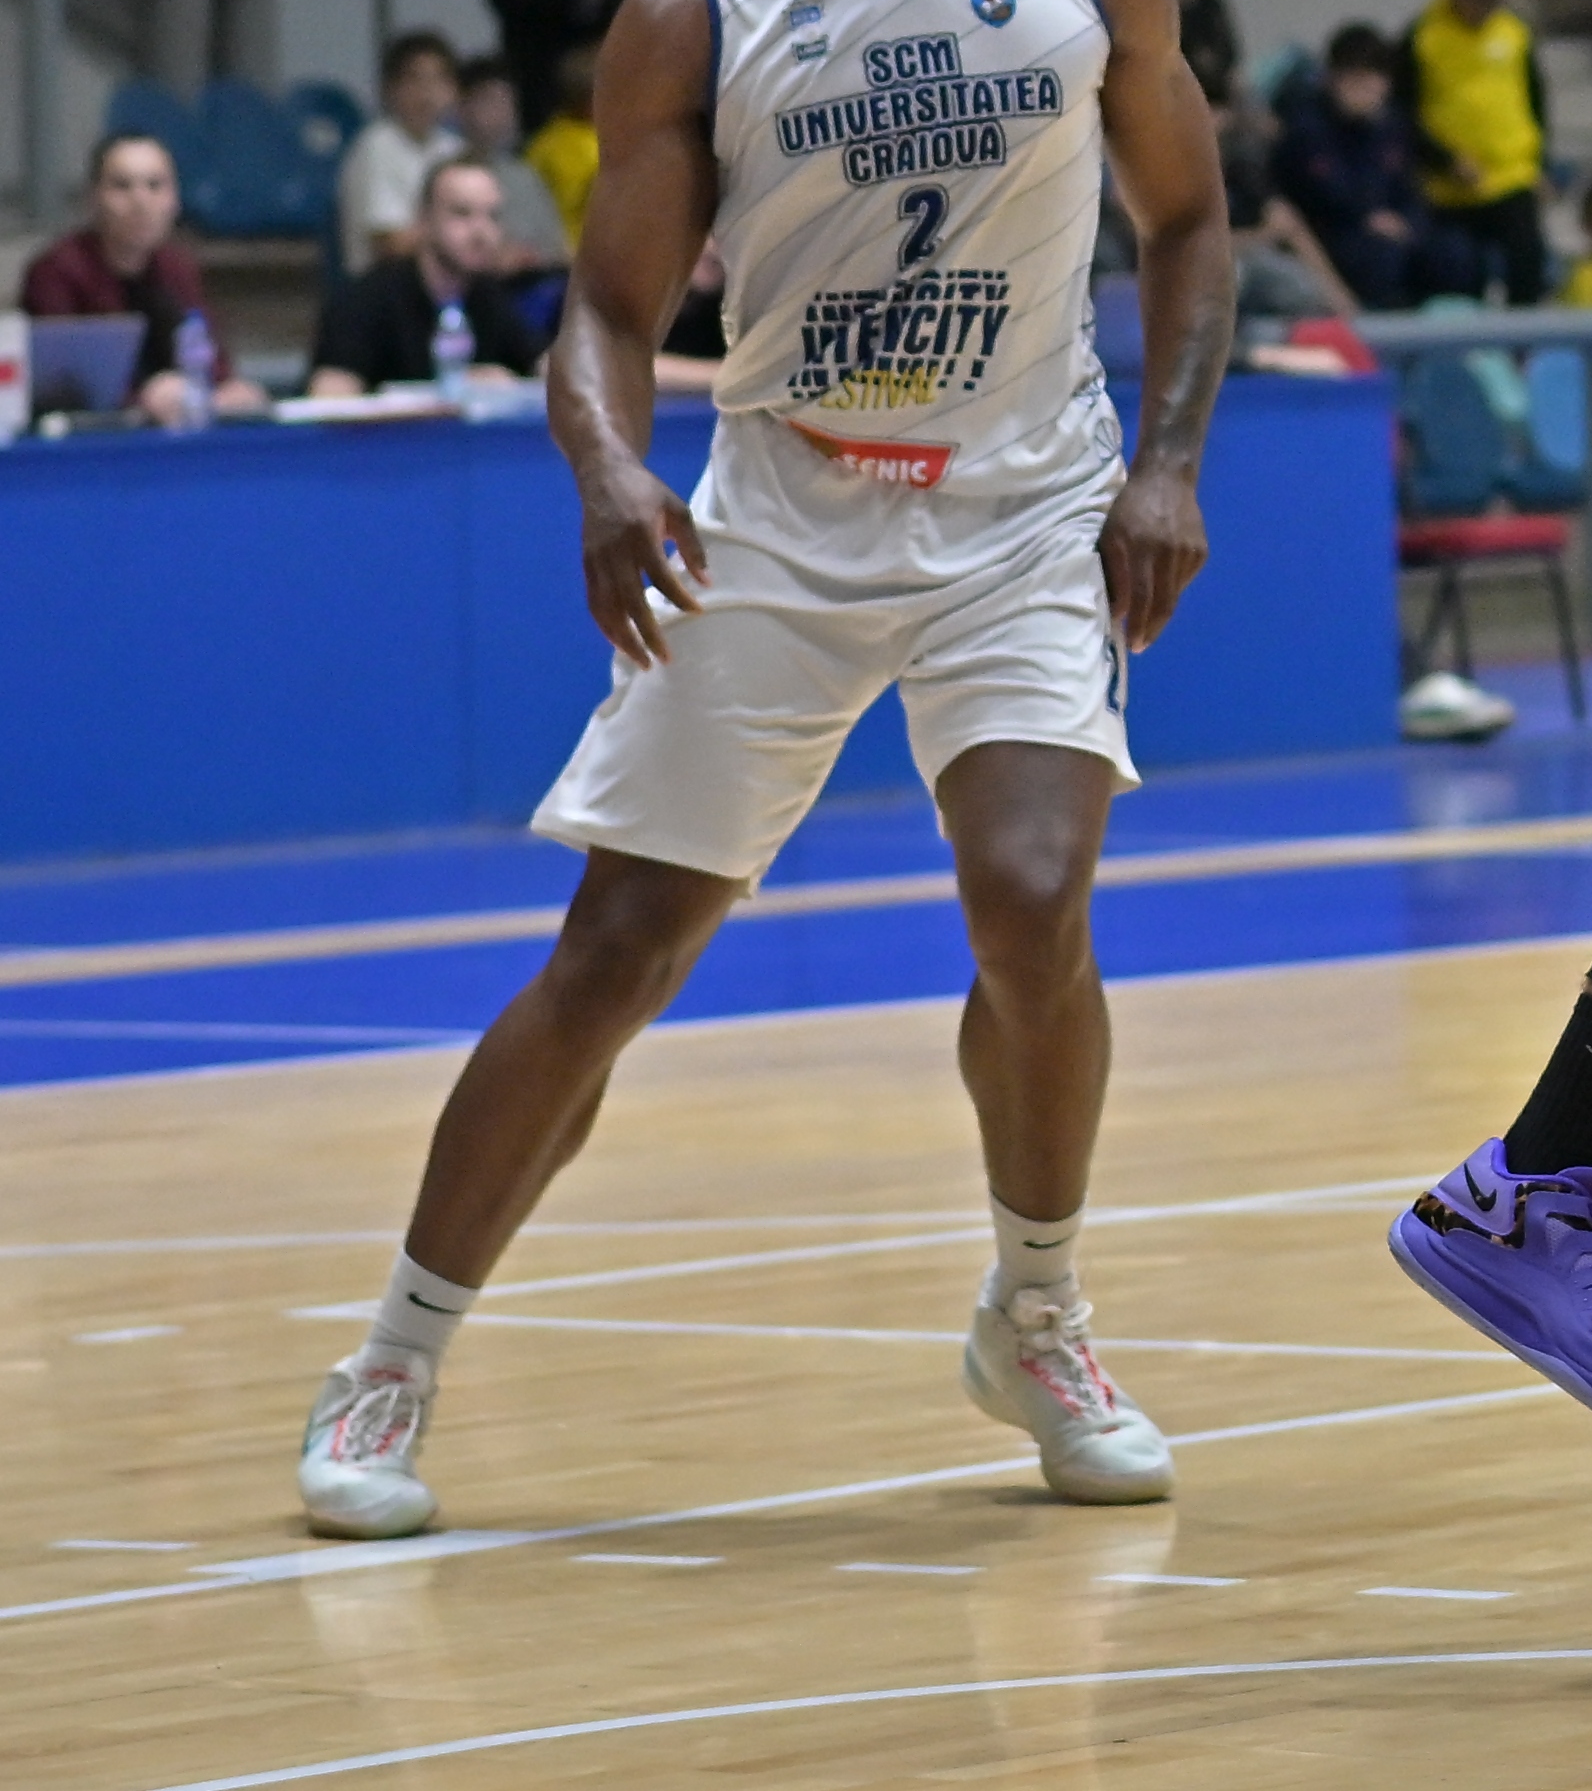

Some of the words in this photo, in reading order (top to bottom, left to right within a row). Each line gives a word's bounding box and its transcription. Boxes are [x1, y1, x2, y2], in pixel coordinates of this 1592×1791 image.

[867, 37, 956, 84] SCM
[780, 73, 1060, 151] UNIVERSITATEA
[849, 124, 1001, 182] CRAIOVA
[898, 183, 949, 271] 2
